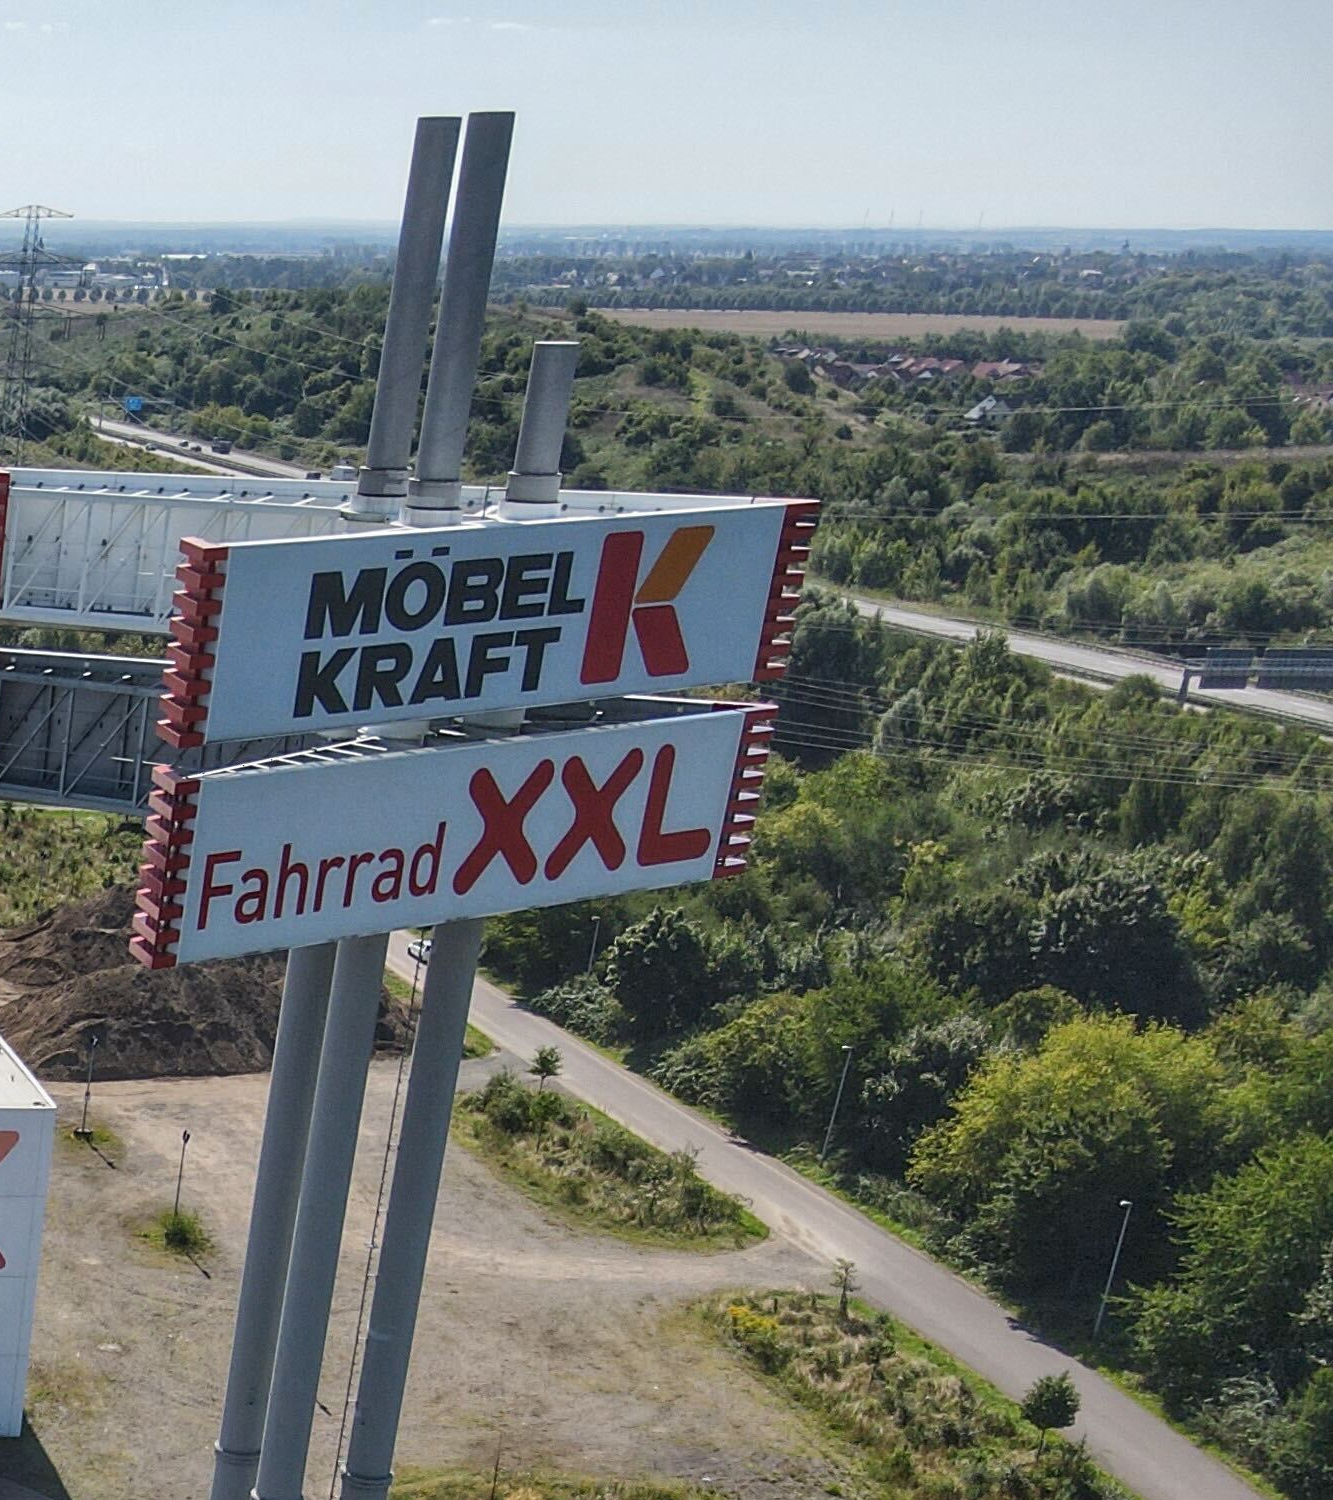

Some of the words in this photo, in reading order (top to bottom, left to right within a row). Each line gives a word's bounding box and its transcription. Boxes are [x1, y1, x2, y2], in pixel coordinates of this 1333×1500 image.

[303, 545, 586, 641] MÖBEL
[293, 626, 562, 720] KRAFT
[196, 821, 446, 931] Fahrrad
[452, 742, 711, 896] XXL
